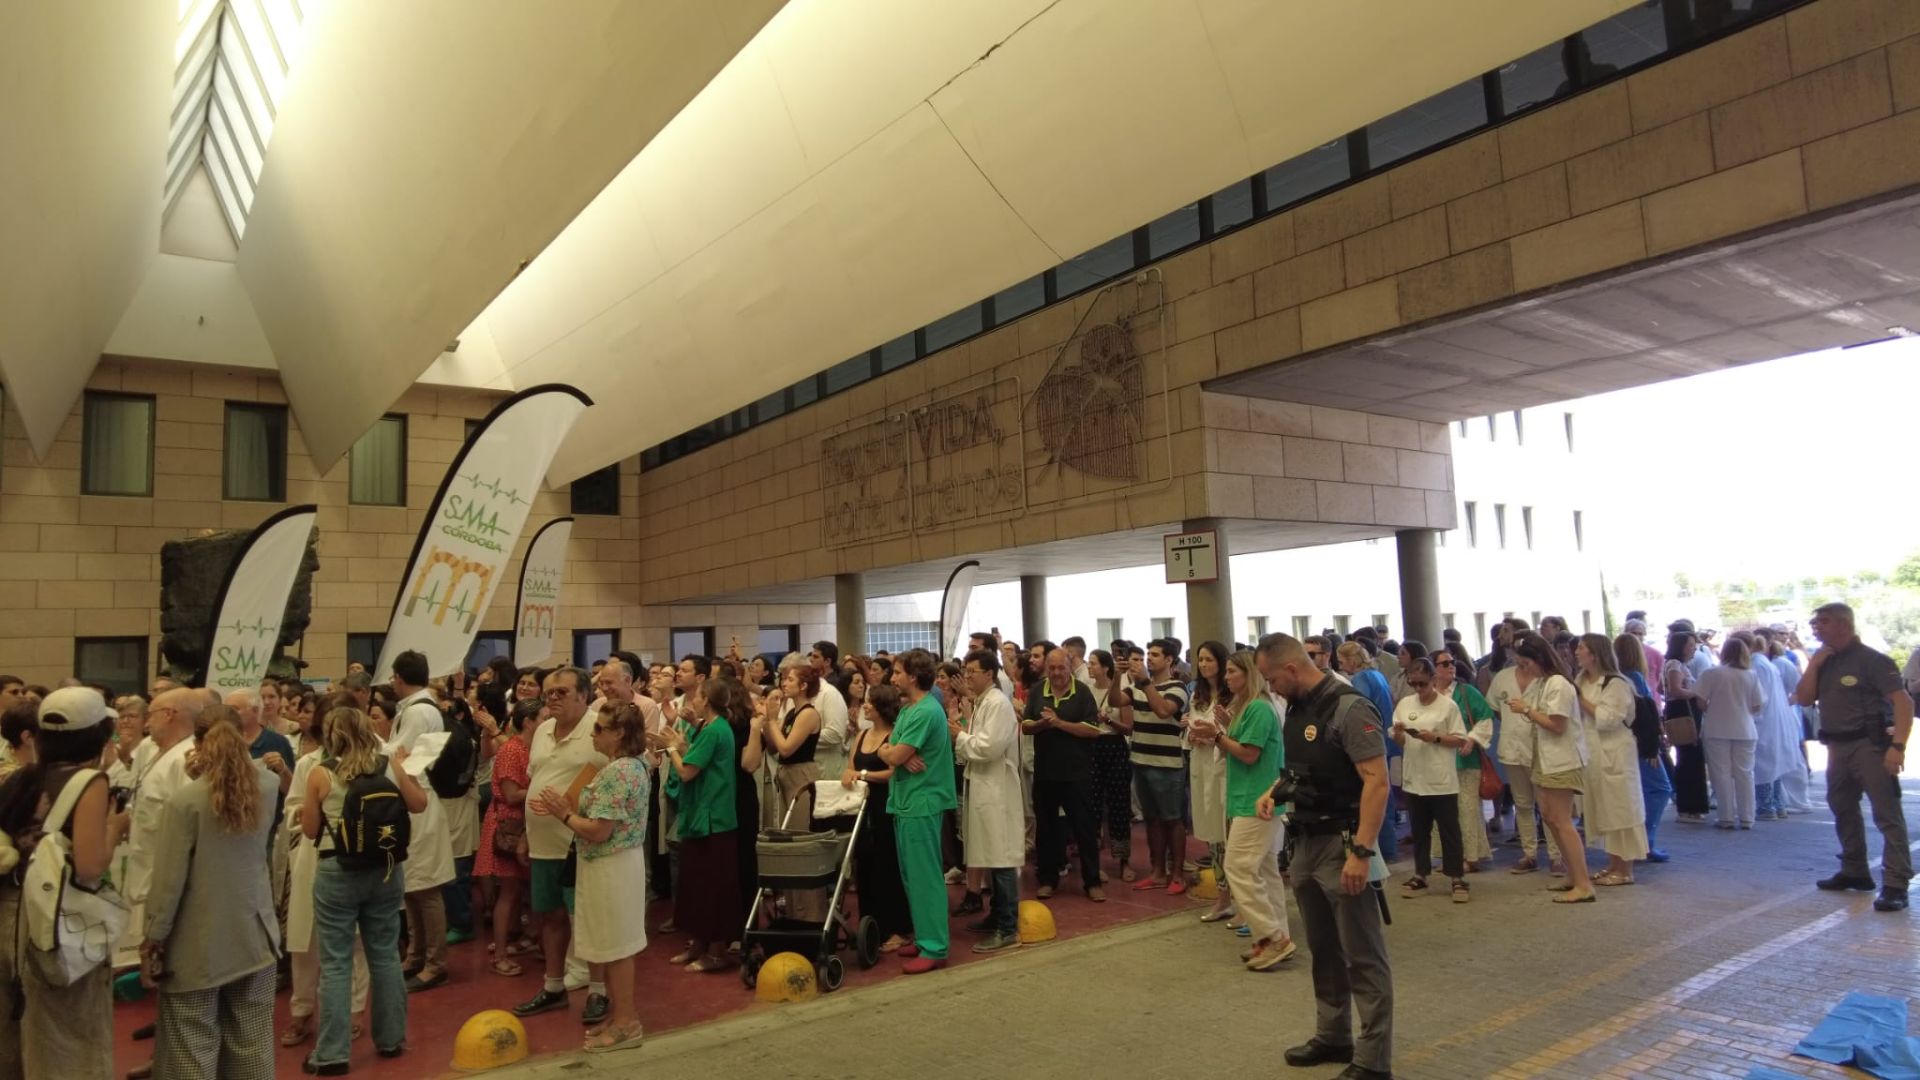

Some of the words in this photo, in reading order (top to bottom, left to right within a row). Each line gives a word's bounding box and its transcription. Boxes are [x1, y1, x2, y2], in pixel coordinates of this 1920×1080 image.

[443, 494, 511, 537] SMA
[442, 524, 502, 553] CÓRDOBA
[1187, 535, 1202, 544] 100
[1174, 552, 1181, 561] 3
[1188, 569, 1195, 578] 5
